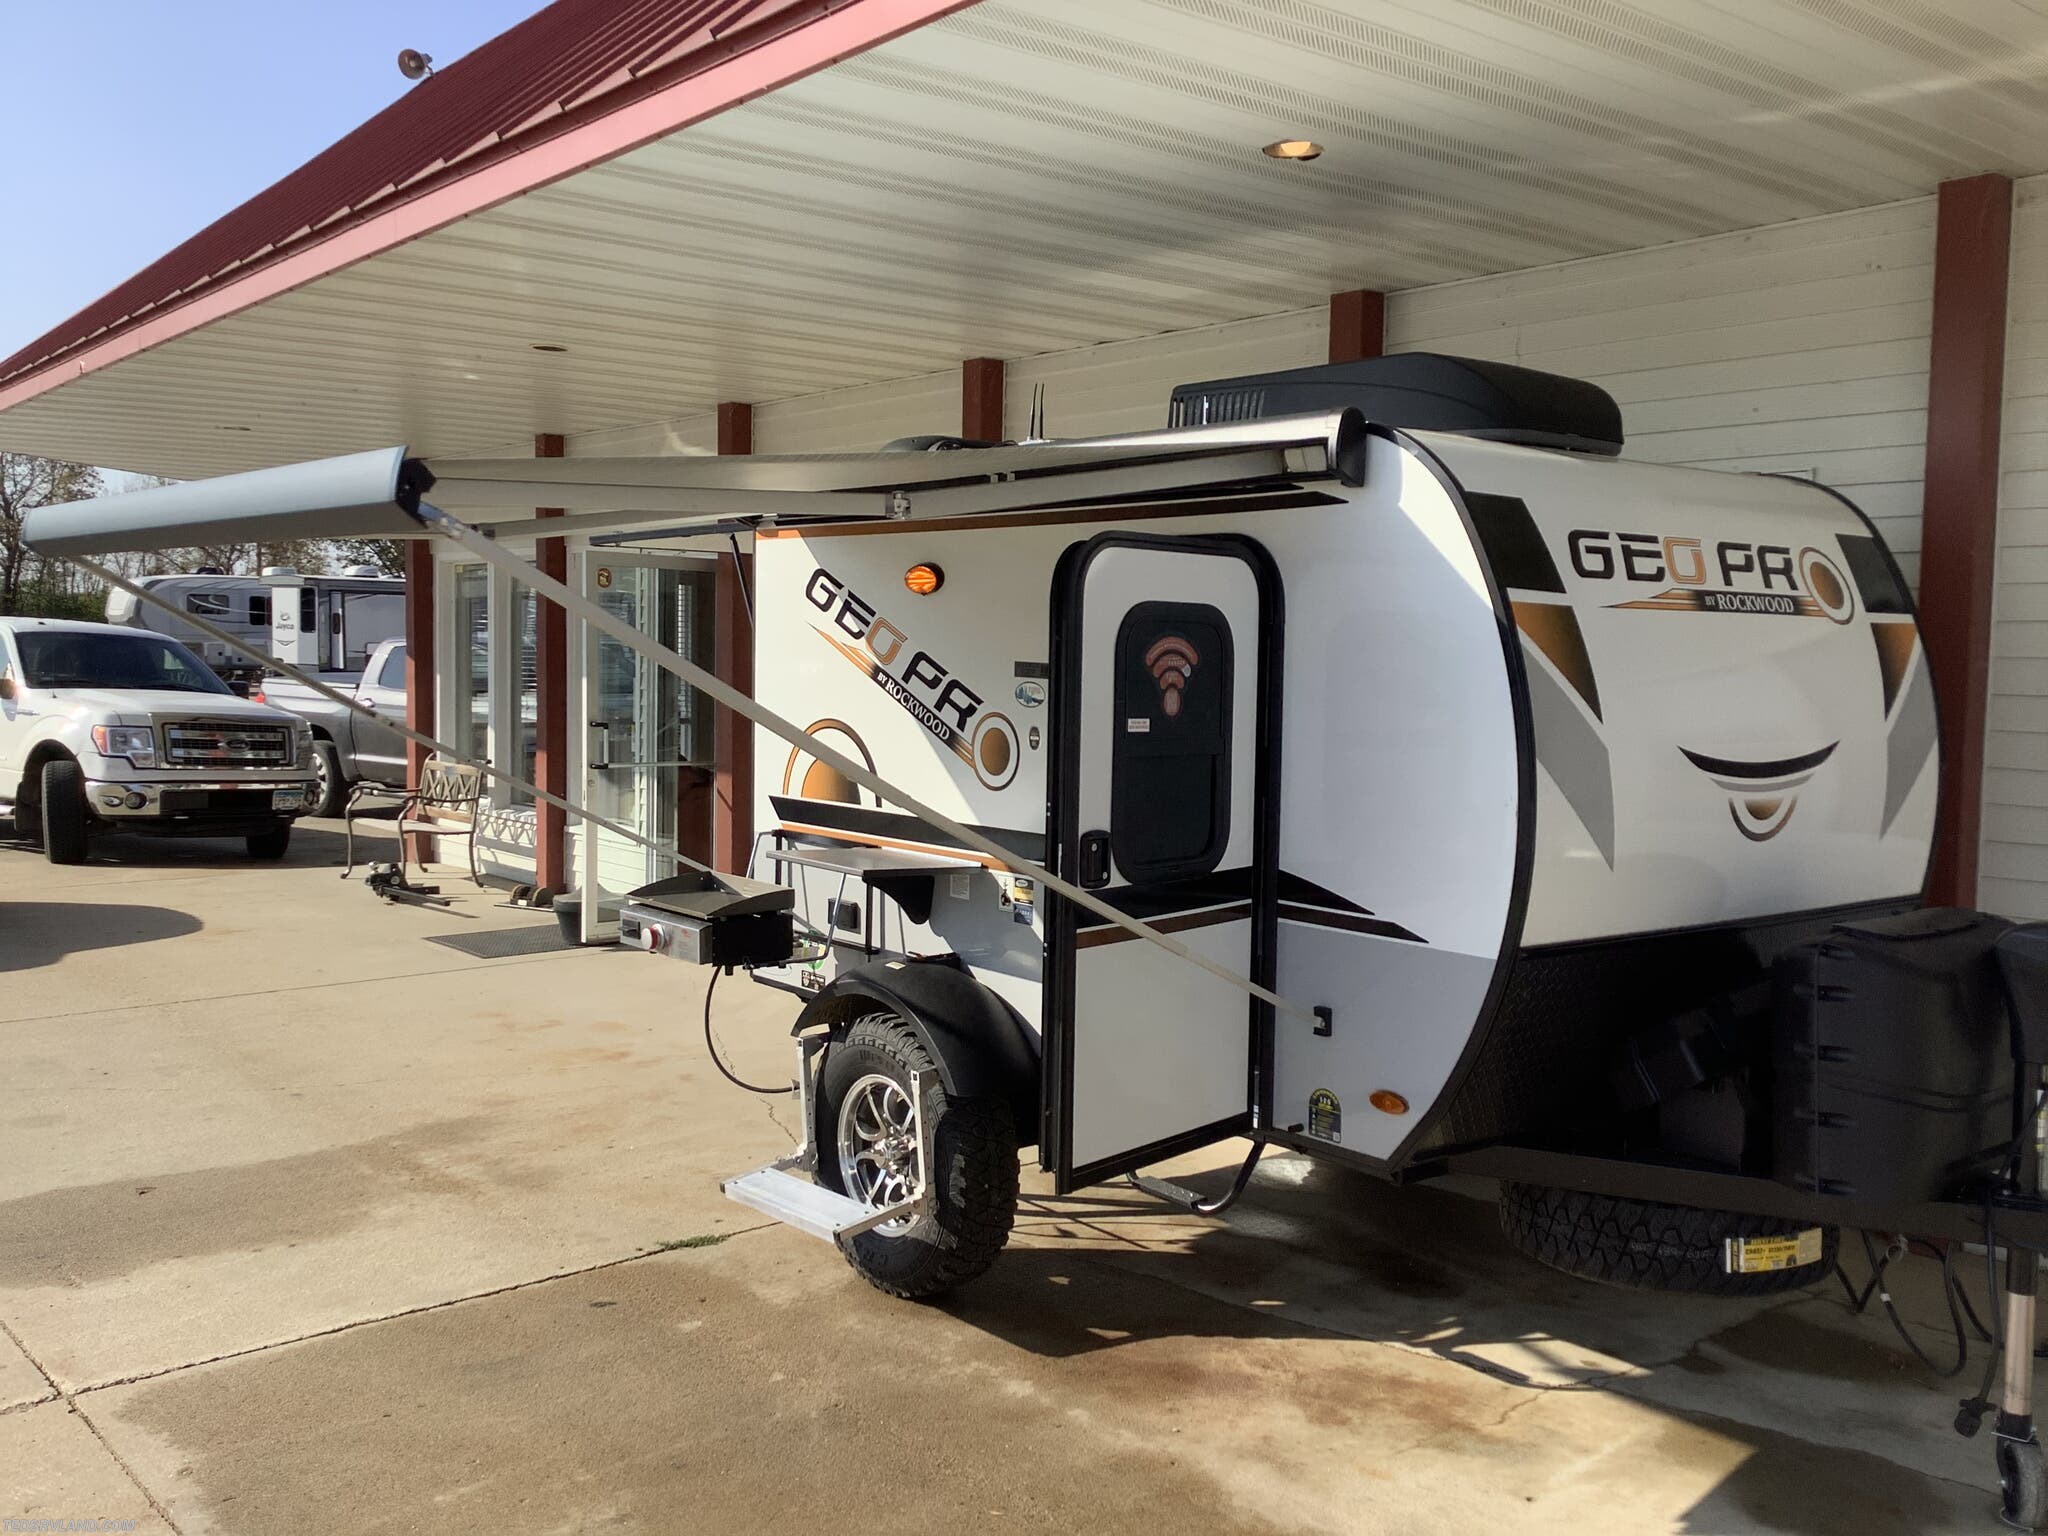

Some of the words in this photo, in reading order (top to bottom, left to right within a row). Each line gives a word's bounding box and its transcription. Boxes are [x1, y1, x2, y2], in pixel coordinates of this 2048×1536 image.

[1568, 529, 1706, 585] GEO
[805, 568, 908, 665] GEO
[1704, 595, 1716, 606] BY
[1716, 593, 1795, 613] ROCKWOOD
[877, 671, 888, 684] BY
[885, 678, 950, 740] ROCKWOOD
